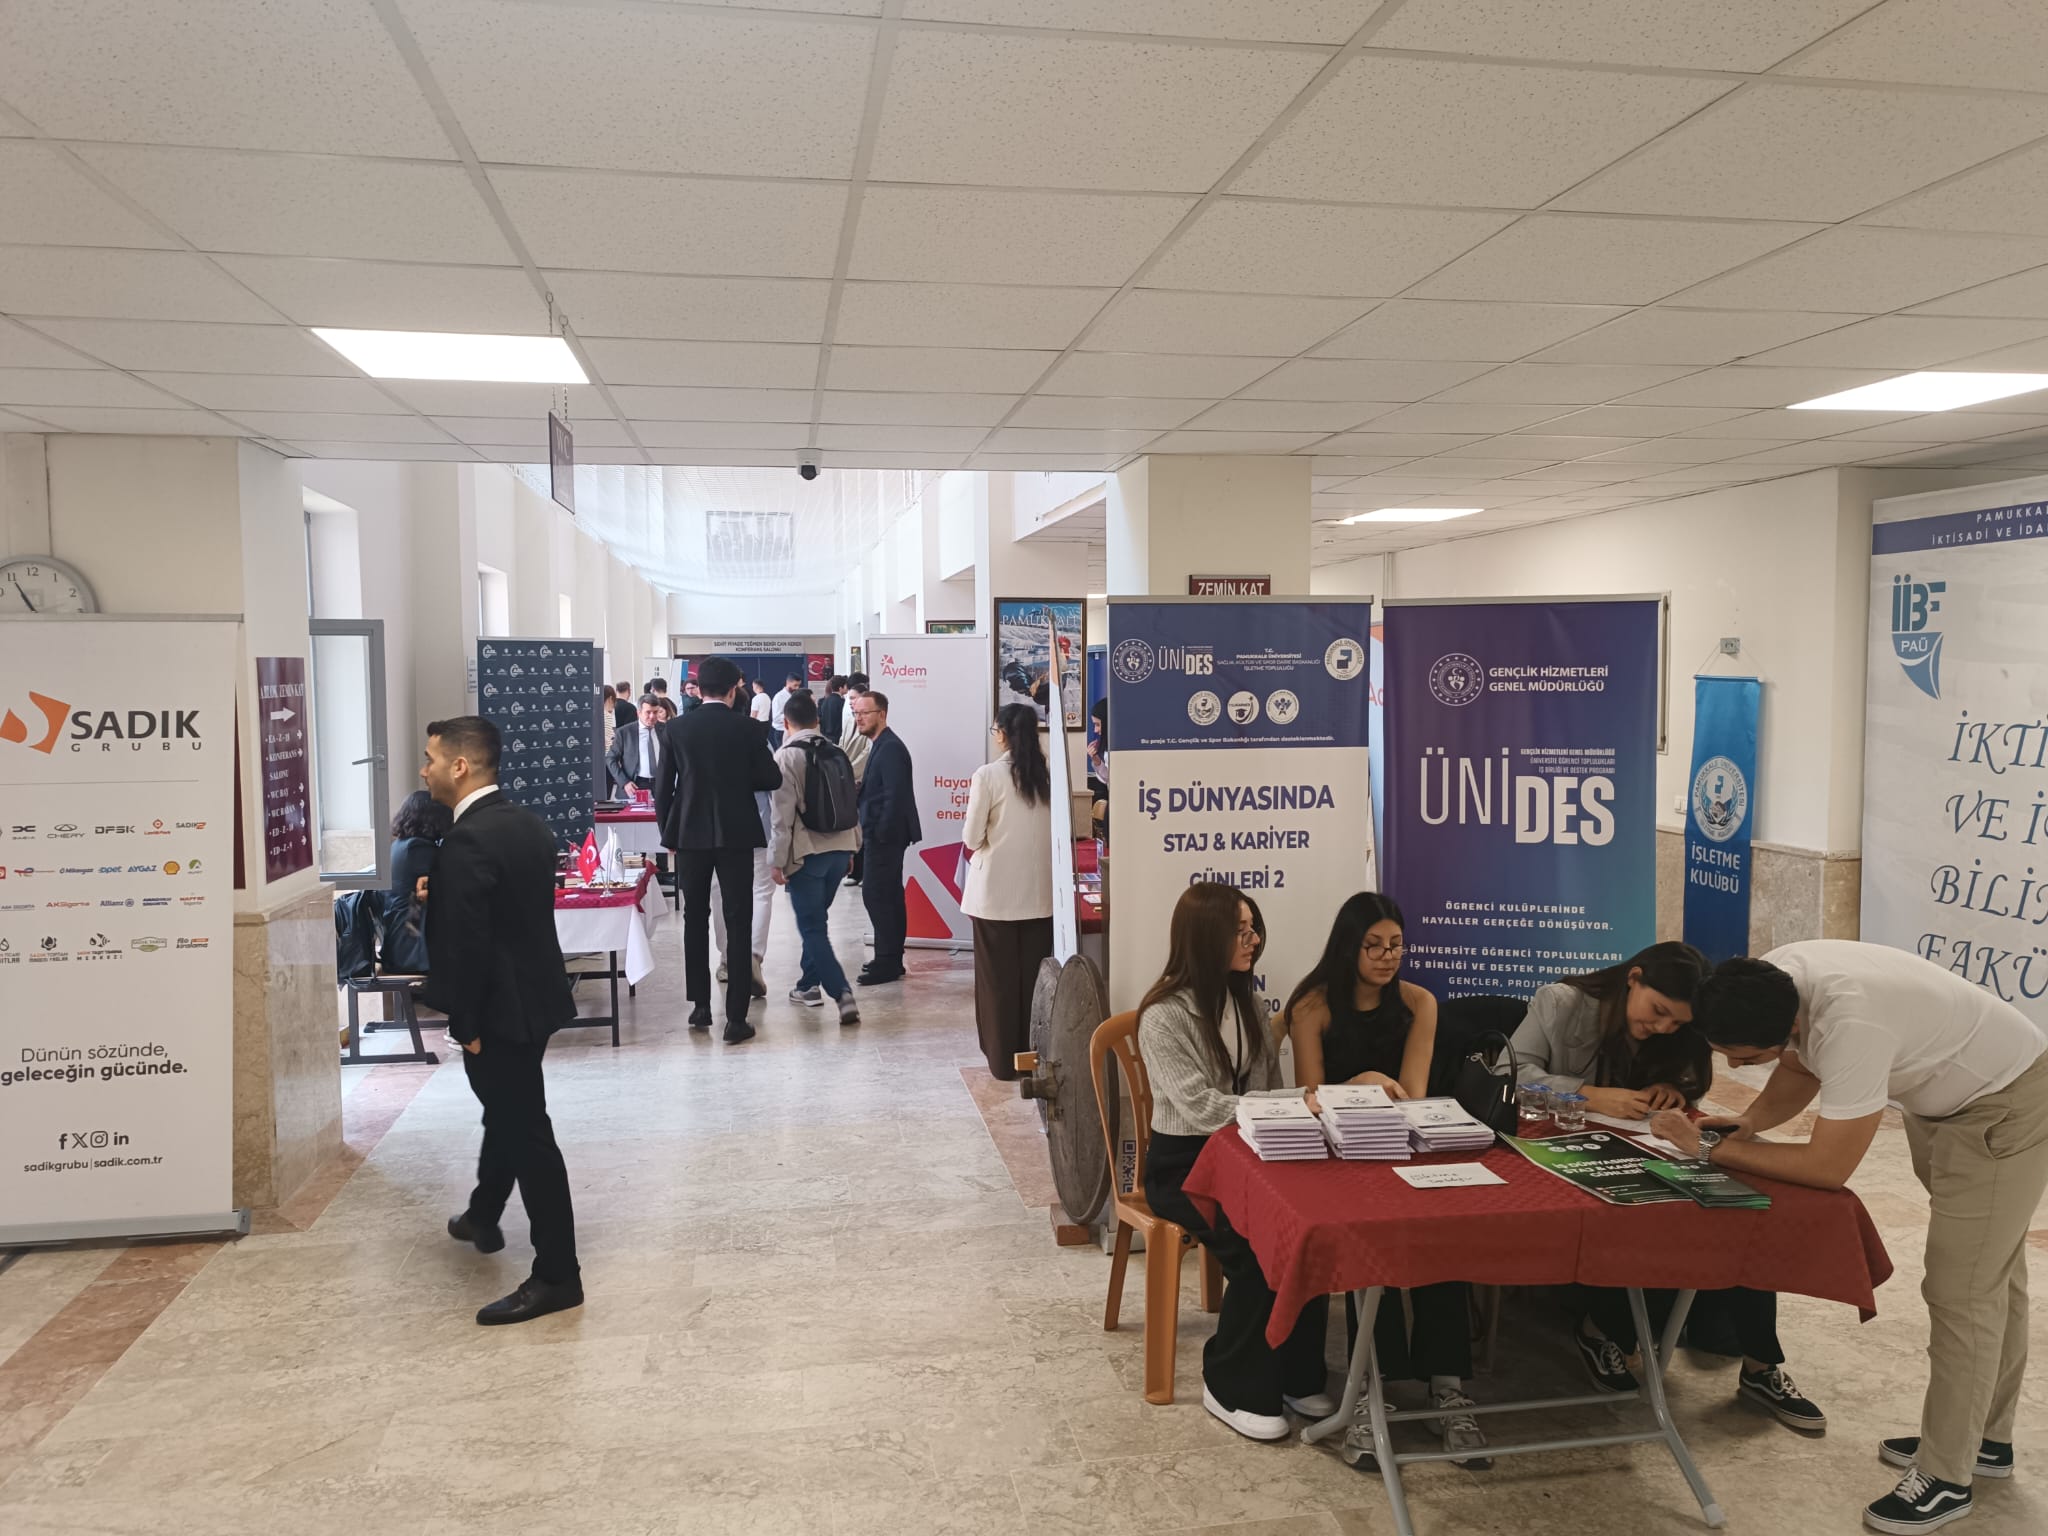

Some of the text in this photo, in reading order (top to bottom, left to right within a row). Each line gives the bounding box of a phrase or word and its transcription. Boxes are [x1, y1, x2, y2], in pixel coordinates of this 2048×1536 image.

[1932, 522, 2048, 545] İKTİSADİ VE İDA
[26, 566, 39, 577] 12
[69, 588, 77, 598] 2
[1198, 579, 1265, 595] ZEMİN KAT
[1901, 637, 1928, 652] PAÜ
[882, 665, 927, 679] Aydem
[1489, 664, 1609, 679] GENÇLİK HİZMETLERİ
[1489, 679, 1605, 692] GENEL MÜDÜRLÜĞÜ
[71, 710, 200, 739] SADIK
[71, 742, 202, 752] GRUBU
[1138, 780, 1335, 820] İŞ DÜNYASINDA
[1945, 789, 2010, 842] VE
[1163, 825, 1310, 852] STAJ & KARİYER
[1691, 841, 1741, 870] İŞLETME
[127, 865, 157, 873] AYGAZ
[1274, 870, 1285, 888] 2
[1690, 868, 1740, 894] KULÜBÜ
[1931, 858, 2048, 926] BİLİ
[1499, 903, 1586, 914] KULÜPLERİNDE
[1422, 916, 1614, 931] HAYALLER GERÇEĞE DÖNÜŞÜYOR.
[1410, 944, 1623, 961] ÜNİVERSİTE ÖĞRENCİ TOPLULUKLARI
[1410, 959, 1420, 969] İŞ
[1425, 959, 1467, 970] BİRLİĞİ
[1472, 963, 1486, 971] VE
[1490, 963, 1534, 973] DESTEK
[1448, 976, 1503, 988] GENÇLER,
[21, 1042, 168, 1063] Dünün sözünde,
[1, 1060, 188, 1086] geleceğin gücünde.
